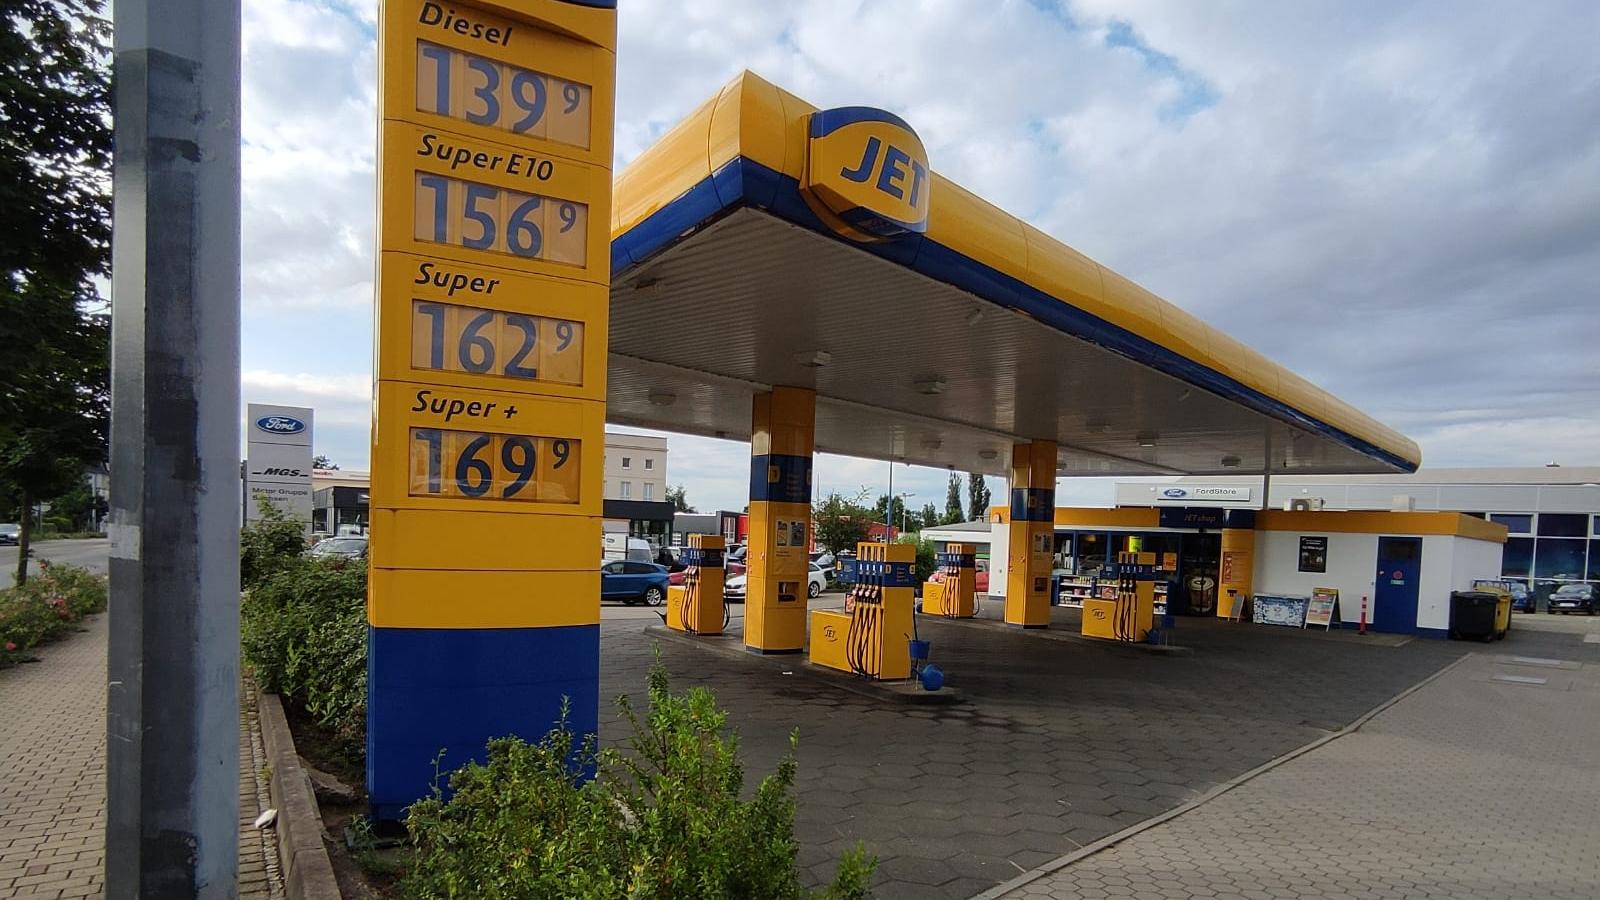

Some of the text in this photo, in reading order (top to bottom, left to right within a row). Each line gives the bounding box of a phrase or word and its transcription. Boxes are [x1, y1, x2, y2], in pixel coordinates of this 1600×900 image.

[418, 1, 513, 47] Diesel
[840, 138, 926, 209] JET
[414, 262, 501, 297] Super
[411, 390, 498, 423] Super
[266, 417, 296, 431] Ford
[278, 488, 308, 496] Gruppe
